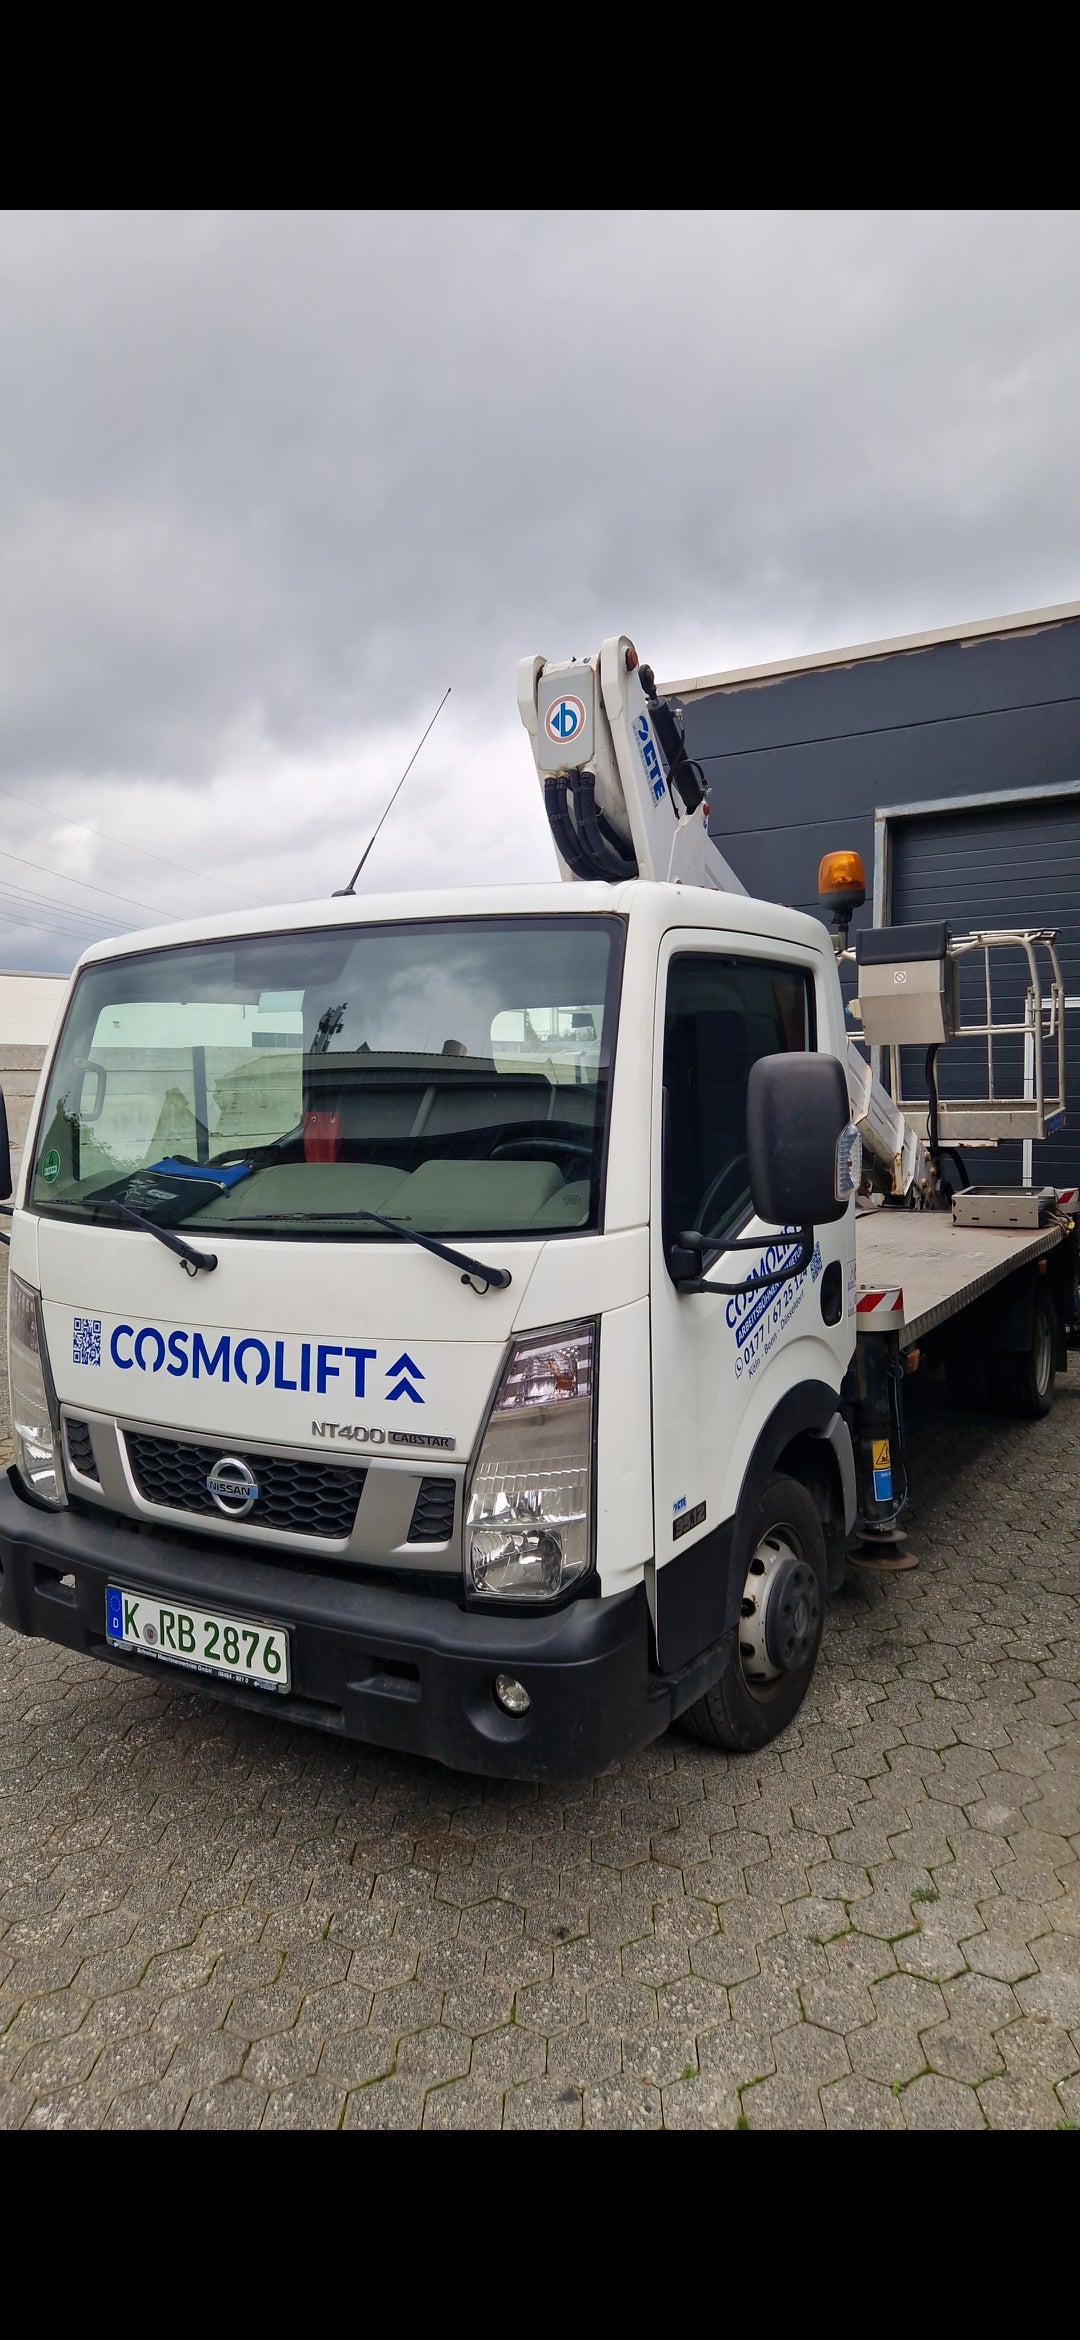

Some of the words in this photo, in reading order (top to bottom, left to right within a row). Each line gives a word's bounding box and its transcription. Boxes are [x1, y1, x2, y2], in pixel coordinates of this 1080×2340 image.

[643, 740, 666, 801] CTE
[743, 1323, 764, 1365] 0177
[773, 1298, 781, 1324] 67
[783, 1283, 793, 1307] 25
[748, 1357, 761, 1379] Köln
[764, 1332, 778, 1355] Bonn
[781, 1288, 804, 1331] Düsseldorf
[110, 1324, 378, 1399] COSMOLIFT
[311, 1419, 386, 1445] NT400
[392, 1431, 450, 1448] CABSTAR
[209, 1481, 251, 1496] NISSAN
[112, 1617, 119, 1629] D
[124, 1599, 140, 1639] K
[159, 1609, 196, 1653] RB
[203, 1620, 282, 1674] 2876
[197, 1665, 213, 1674] GmbH
